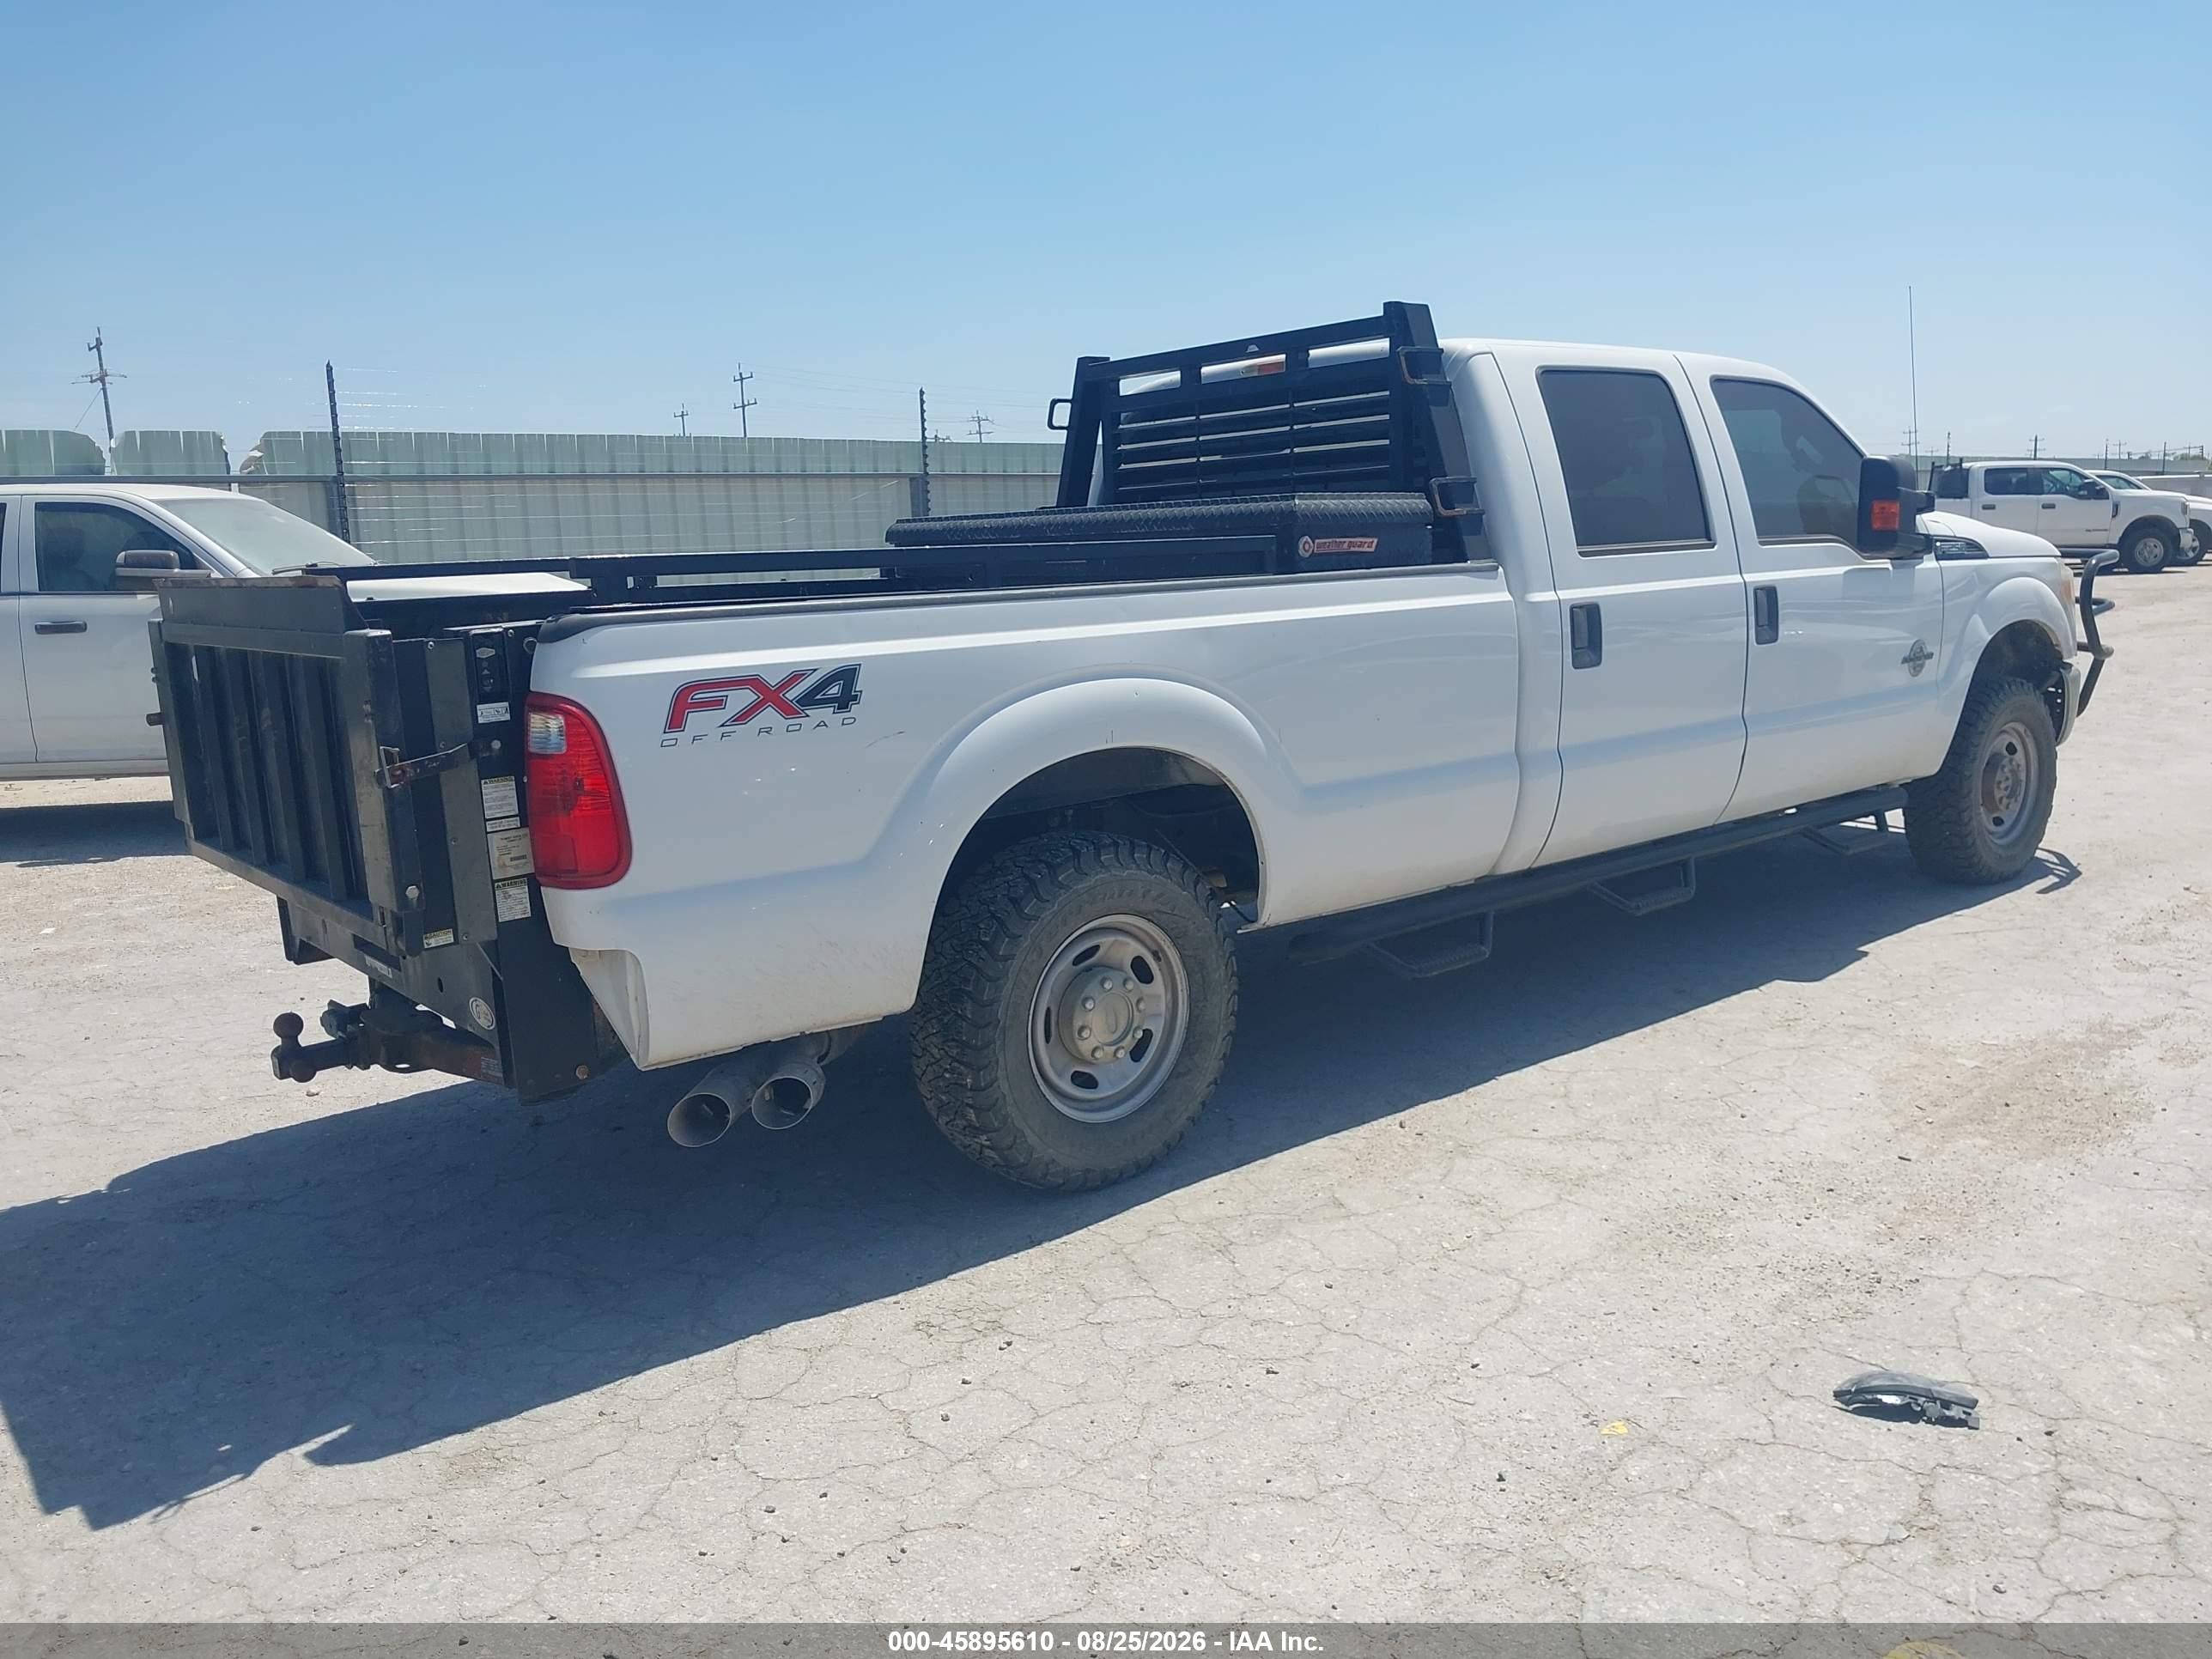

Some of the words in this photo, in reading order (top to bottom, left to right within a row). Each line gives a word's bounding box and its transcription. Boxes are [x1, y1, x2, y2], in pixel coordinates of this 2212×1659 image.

[1347, 539, 1375, 550] guard
[663, 663, 863, 733] FX4
[660, 730, 737, 747] OFF
[757, 716, 857, 737] ROAD
